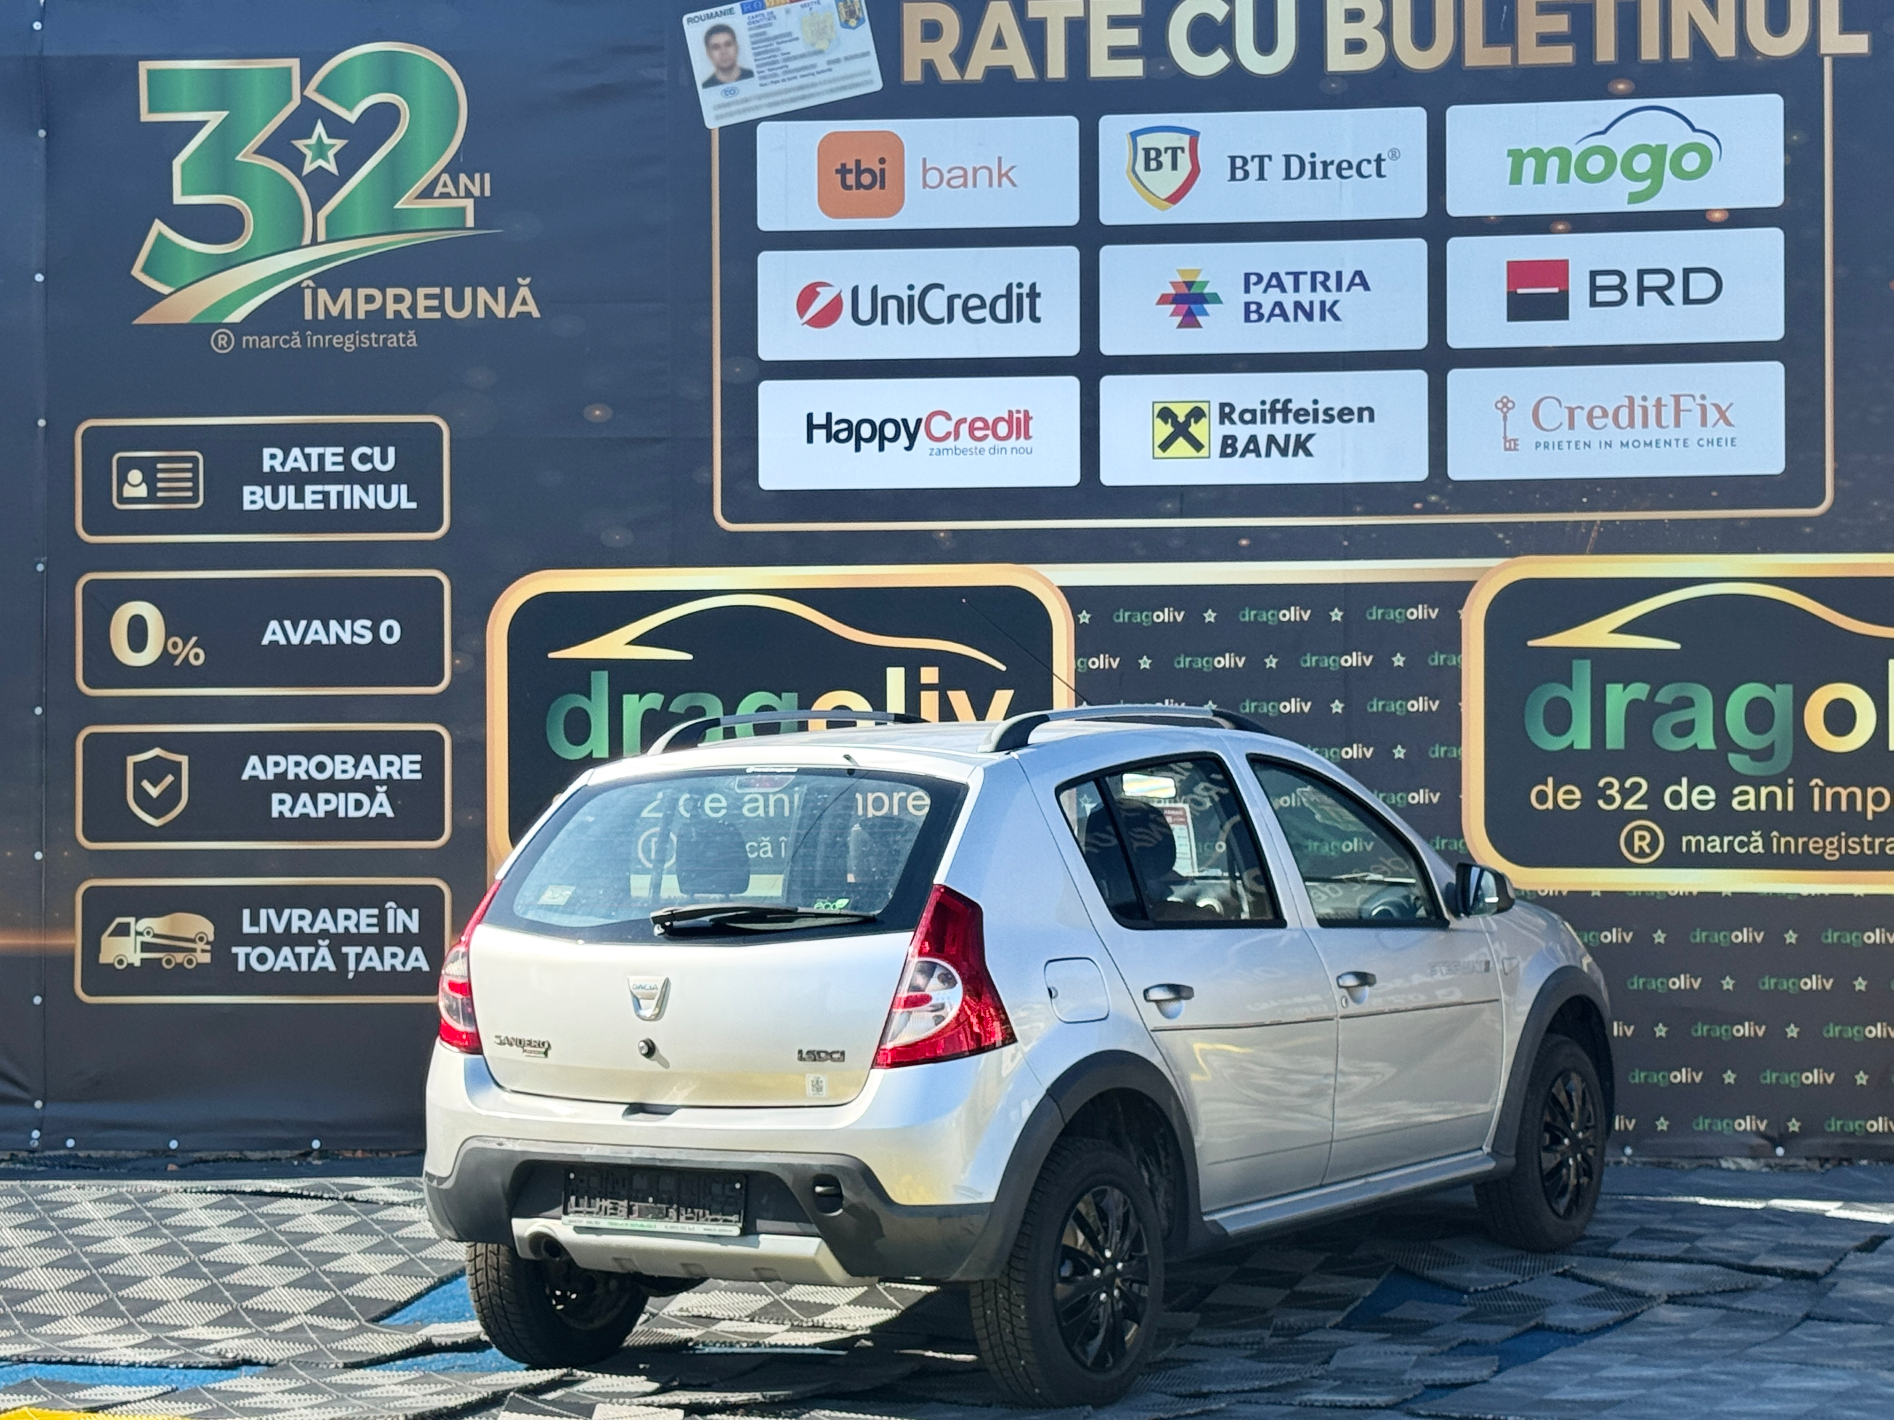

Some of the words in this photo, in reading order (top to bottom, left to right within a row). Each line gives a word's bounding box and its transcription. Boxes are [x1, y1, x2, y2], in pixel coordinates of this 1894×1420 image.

[687, 8, 735, 25] ROUMANIE
[901, 0, 1146, 83] RATE
[1167, 0, 1298, 77] CU
[1325, 0, 1870, 73] BULETINUL
[131, 40, 475, 296] 32
[1143, 146, 1186, 173] BT
[1227, 155, 1273, 183] BT
[433, 172, 491, 198] ANI
[835, 156, 887, 191] tbi
[921, 157, 1019, 190] bank
[1506, 141, 1714, 206] mogo
[1243, 269, 1371, 295] PATRIA
[1588, 267, 1724, 308] BRD
[302, 277, 541, 320] ÎMPREUNĂ
[850, 281, 1042, 327] UniCredit
[1243, 300, 1342, 324] BANK
[241, 331, 302, 350] marcă
[306, 329, 418, 352] înregistrată
[1218, 399, 1376, 427] Raiffeisen
[1531, 393, 1737, 433] CreditFix
[928, 446, 986, 457] zambeste
[988, 444, 1009, 455] din
[1011, 446, 1034, 455] nou
[1218, 433, 1316, 460] BANK
[1534, 440, 1592, 451] PRIETEN
[1599, 440, 1613, 451] IN
[1619, 438, 1690, 450] MOMENTE
[1696, 437, 1738, 449] CHEIE
[262, 446, 345, 474] RATE
[350, 446, 396, 472] CU
[241, 485, 418, 512] BULETINUL
[1113, 607, 1185, 626] dragoliv
[1239, 606, 1311, 625] dragoliv
[1366, 604, 1439, 623] dragoliv
[261, 619, 373, 646] AVANS
[378, 618, 402, 645] 0
[1075, 653, 1120, 673] goliv
[1174, 653, 1246, 671] dragoliv
[1300, 651, 1374, 671] dragoliv
[1239, 698, 1312, 716] dragoliv
[1367, 696, 1440, 716] dragoliv
[1523, 658, 1894, 777] drago
[241, 753, 423, 781] APROBARE
[270, 785, 395, 819] RAPIDĂ
[1529, 776, 1582, 812] de
[1596, 776, 1649, 811] 32
[1663, 776, 1717, 812] de
[1731, 778, 1795, 812] ani
[1681, 829, 1764, 855] marcă
[242, 907, 380, 935] LIVRARE
[385, 900, 420, 934] ÎN
[1690, 928, 1765, 947] dragoliv
[231, 939, 336, 973] TOATĂ
[341, 946, 430, 979] ȚARA
[632, 983, 659, 991] DACIA
[1627, 973, 1702, 993] dragoliv
[1758, 974, 1834, 994] dragoliv
[1691, 1021, 1766, 1041] dragoliv
[1628, 1067, 1703, 1087] dragoliv
[1759, 1068, 1835, 1088] dragoliv
[1692, 1115, 1768, 1135] dragoliv
